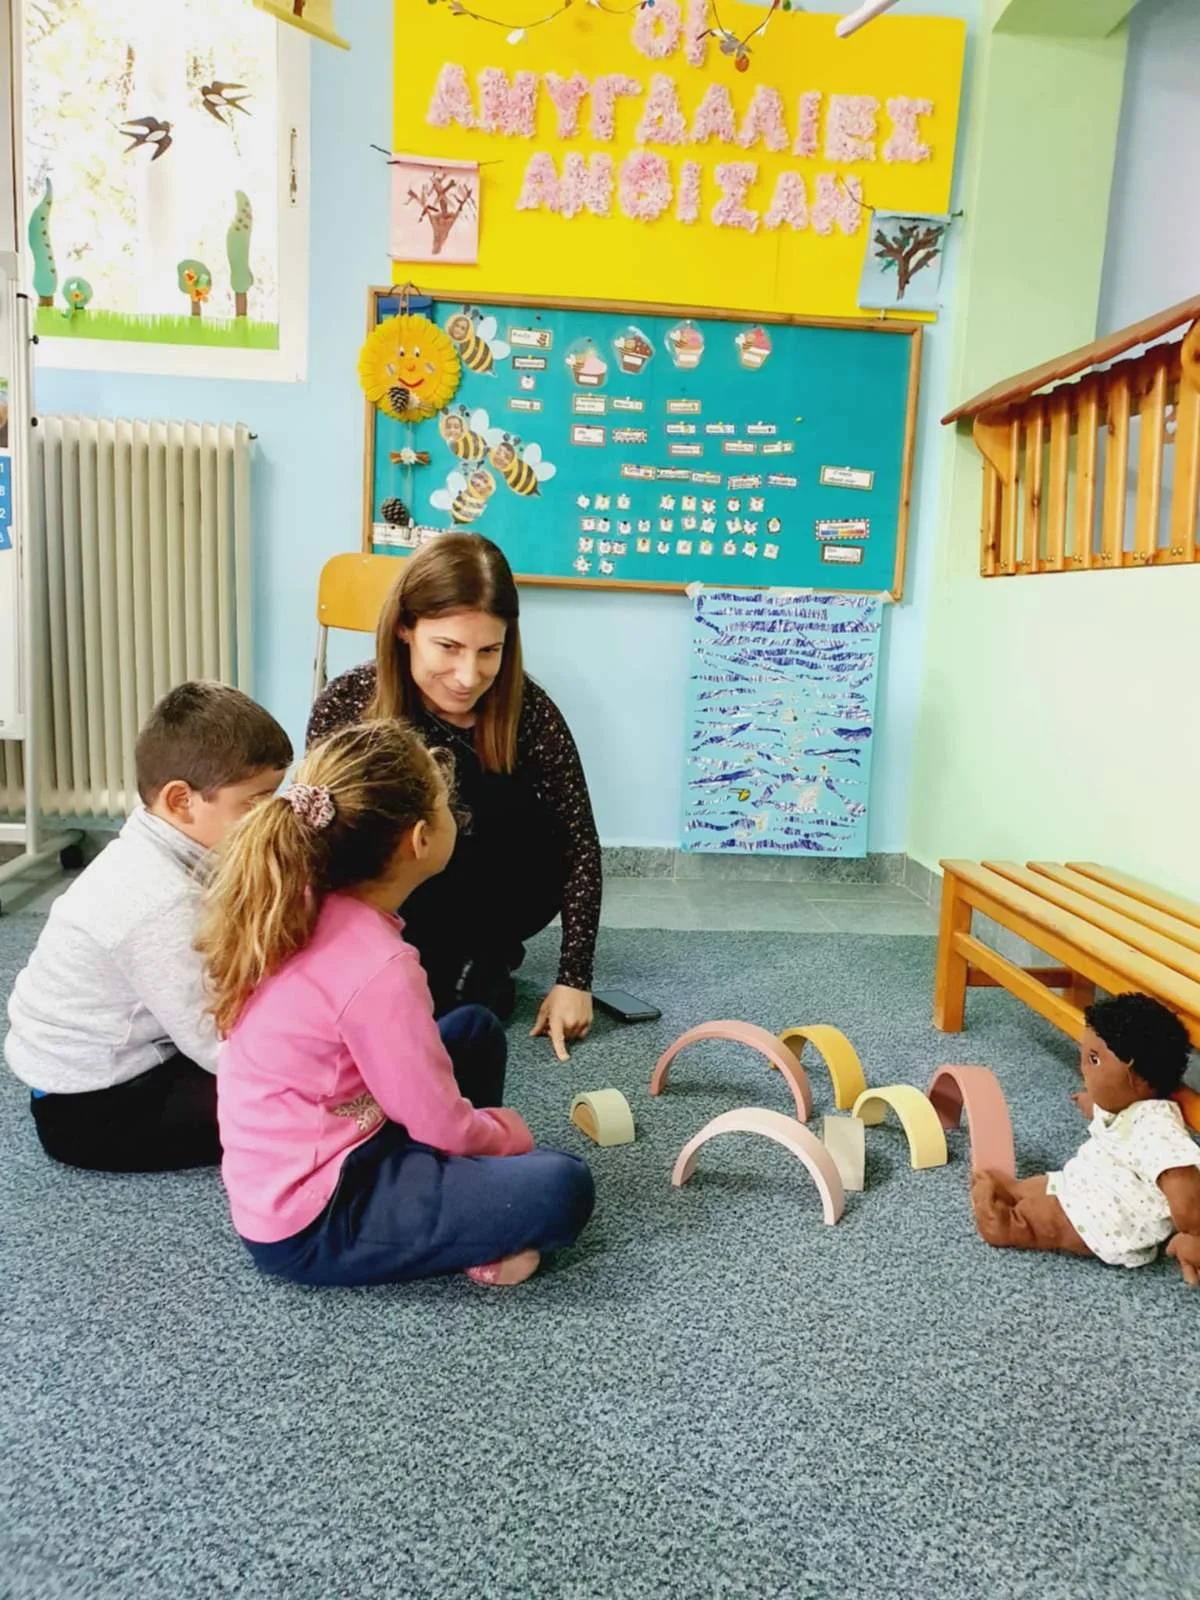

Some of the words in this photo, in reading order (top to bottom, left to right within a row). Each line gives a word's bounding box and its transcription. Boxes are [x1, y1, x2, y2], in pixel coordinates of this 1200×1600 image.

[631, 0, 706, 66] ΟΙ
[425, 61, 934, 163] ΑΜΥΓΔΑΛΙΕΣ
[515, 148, 864, 236] ΑΝΘΙΖΑΝ
